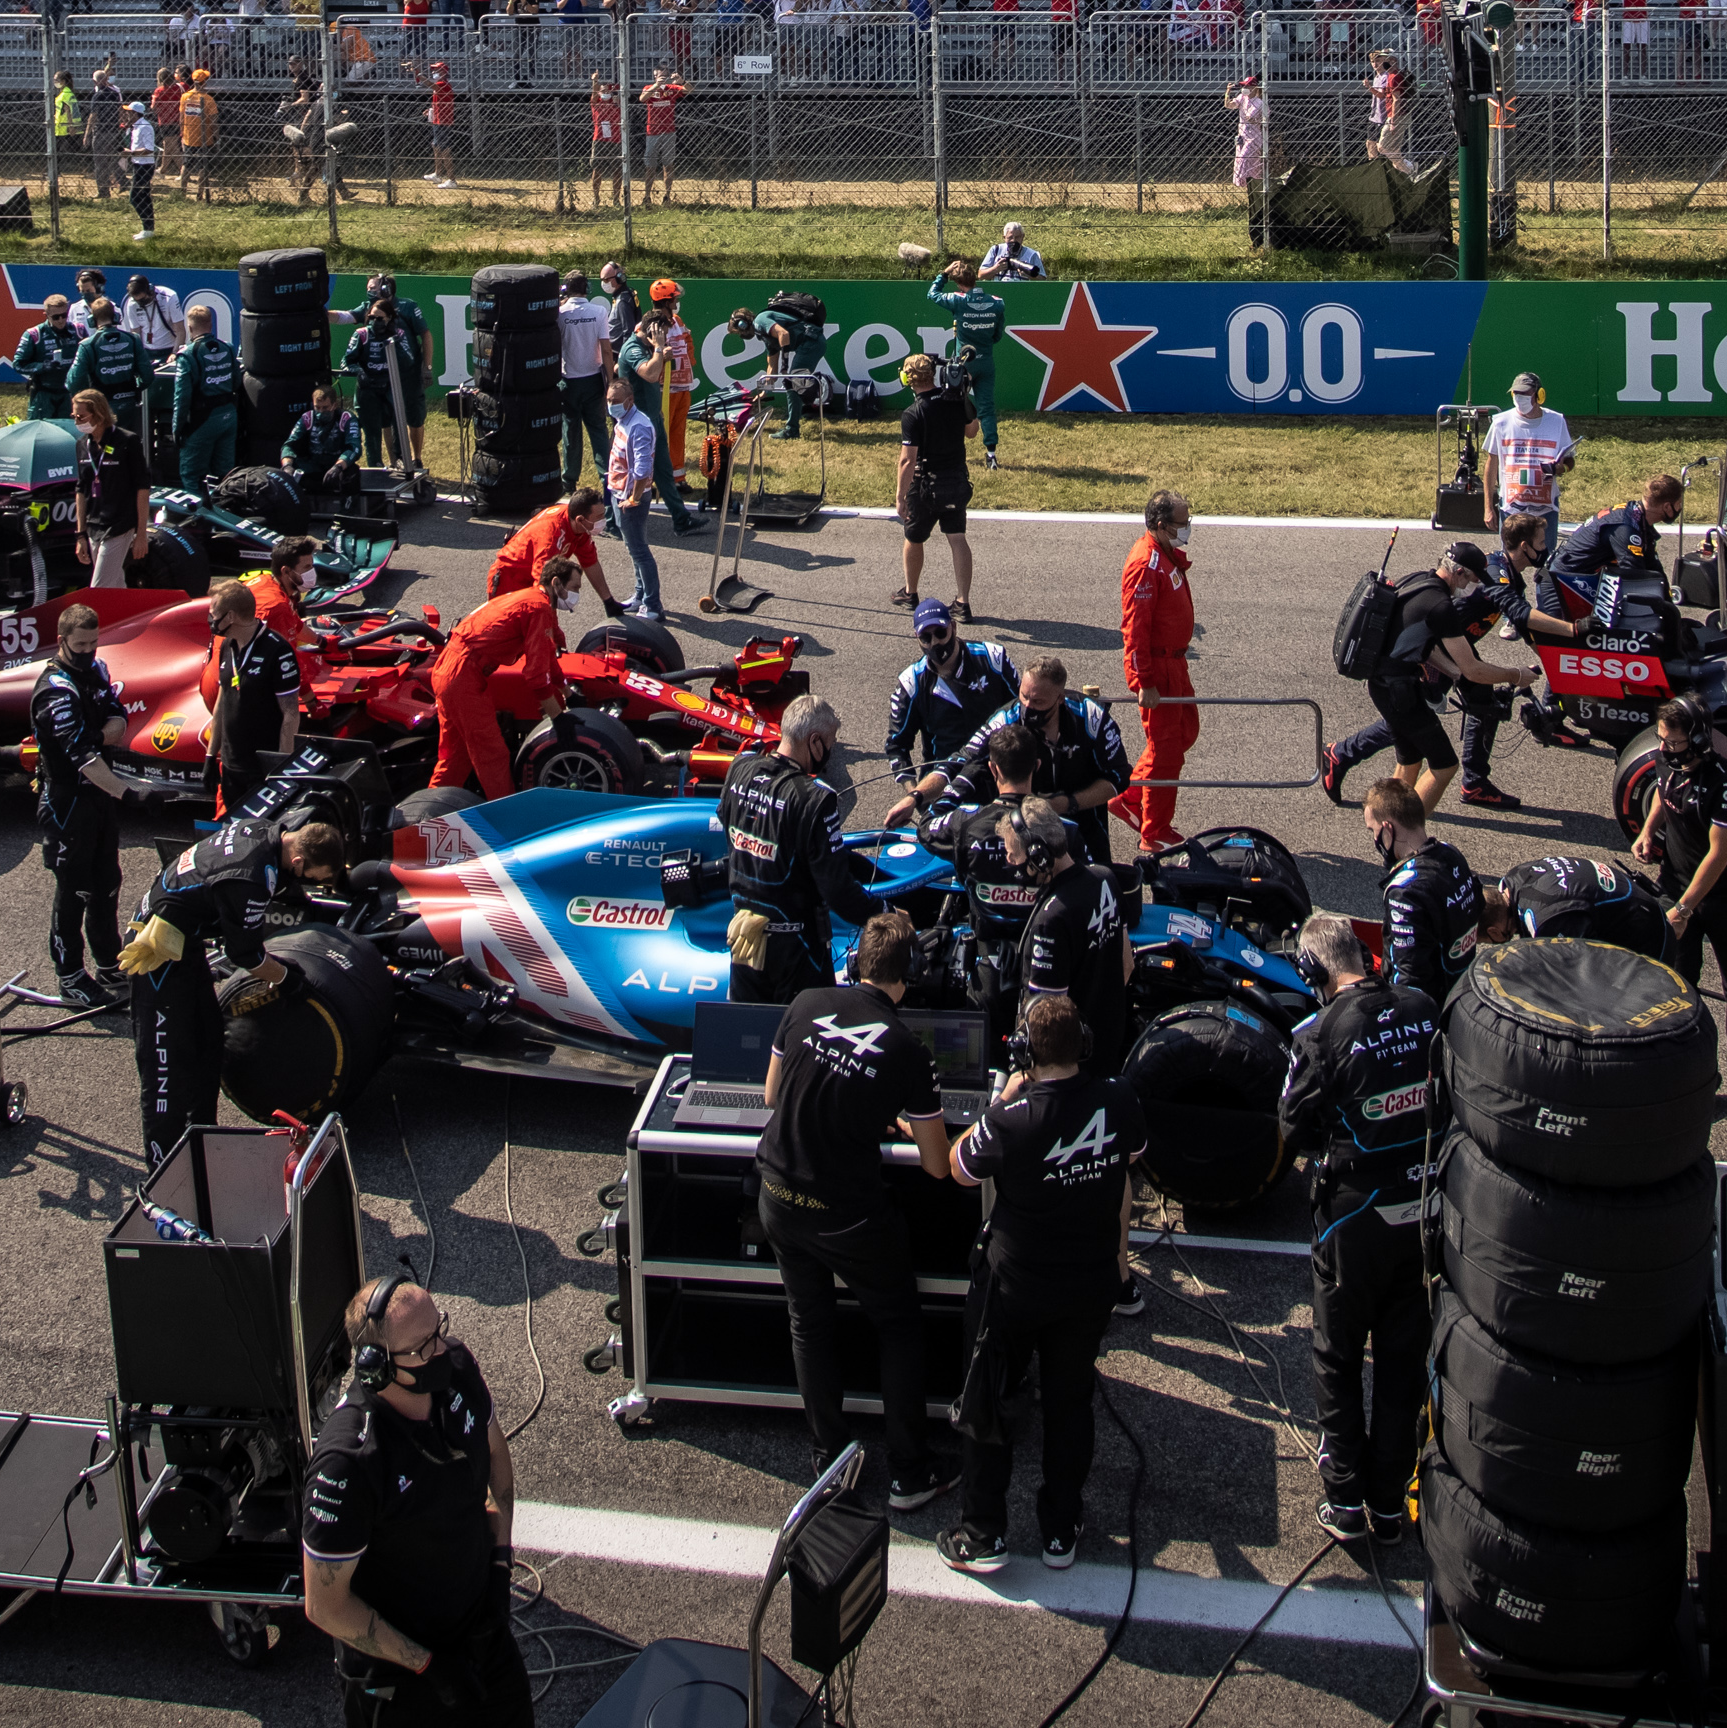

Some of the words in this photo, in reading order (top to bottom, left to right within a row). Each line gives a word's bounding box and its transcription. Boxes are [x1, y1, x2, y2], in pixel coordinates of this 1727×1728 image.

[737, 60, 747, 70] 6°
[751, 61, 771, 70] Row
[275, 284, 291, 294] LEFT
[527, 301, 544, 311] LEFT
[563, 316, 597, 326] Cognizant
[963, 322, 995, 330] Cognizant
[279, 342, 301, 353] RIGHT
[303, 340, 321, 351] REAR
[1225, 302, 1365, 404] 0.0
[100, 363, 133, 375] Cognizant
[525, 358, 546, 369] RIGHT
[205, 372, 232, 385] Cognizant
[288, 402, 307, 414] LEFT
[531, 418, 547, 428] LEFT
[47, 466, 73, 478] BWT
[266, 470, 283, 482] LEFT
[283, 480, 301, 505] FRONT
[1, 618, 39, 654] 55
[1585, 634, 1641, 653] Claro
[3, 656, 32, 672] aws
[1559, 654, 1650, 682] ESSO
[626, 672, 664, 697] 55
[1597, 703, 1649, 724] Tezos
[155, 724, 179, 743] ups
[111, 760, 137, 774] brembo
[143, 766, 163, 776] NGK
[729, 782, 785, 810] ALPINE
[753, 802, 768, 816] TEAM
[419, 823, 467, 866] 14
[603, 838, 667, 852] RENAULT
[733, 830, 775, 860] Castrol
[593, 900, 667, 928] Castrol
[1349, 1020, 1433, 1054] ALPINE
[1393, 1040, 1417, 1054] TEAM
[155, 1010, 168, 1114] ALPINE
[802, 1035, 877, 1078] ALPINE
[830, 1062, 851, 1078] TEAM
[1537, 1106, 1587, 1126] Front
[1535, 1118, 1573, 1137] Left
[1043, 1153, 1120, 1181] ALPINE
[1078, 1172, 1102, 1183] TEAM
[1563, 1272, 1606, 1289] Rear
[1557, 1284, 1597, 1300] Left
[1579, 1451, 1621, 1464] Rear
[1575, 1461, 1622, 1476] Right
[318, 1494, 343, 1504] RENAULT
[1499, 1588, 1546, 1612] Front
[1495, 1596, 1543, 1622] Right
